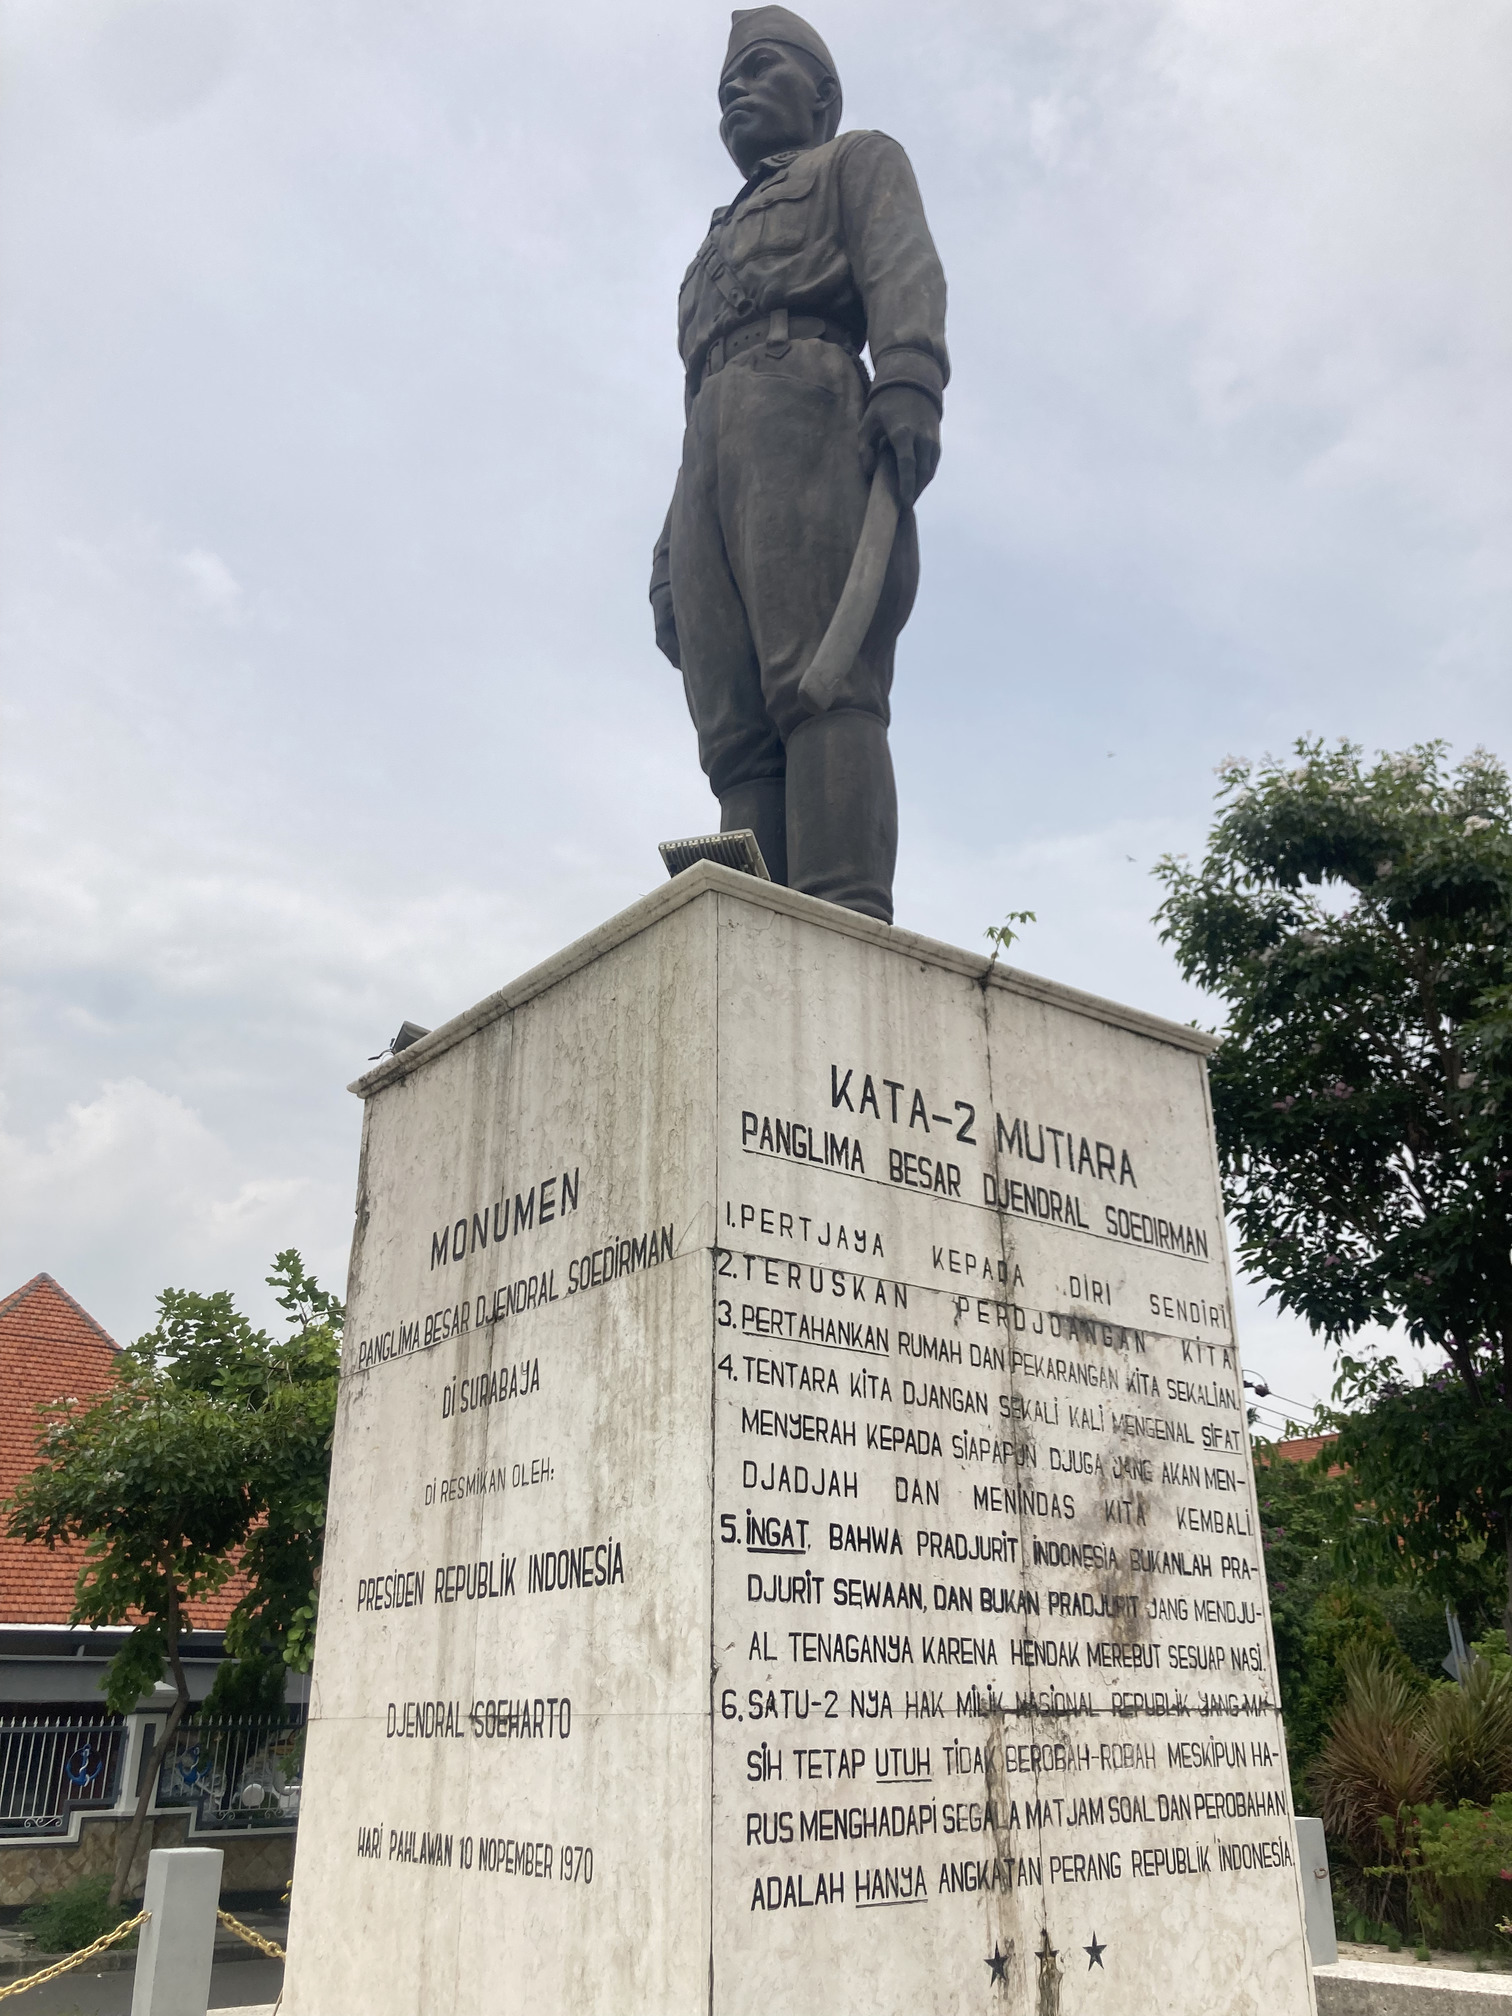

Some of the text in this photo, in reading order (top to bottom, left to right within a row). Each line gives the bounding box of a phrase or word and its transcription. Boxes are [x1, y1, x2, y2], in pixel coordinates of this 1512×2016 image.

[831, 1064, 1138, 1188] KATA-2 MUTIARA
[430, 1167, 579, 1270] MONUMEN
[742, 1111, 1209, 1259] PANGLIMA BESAR DJENDRAL SOEDIRMAN
[358, 1223, 674, 1370] PANGLIMA BESAR DJENDRAL SOEDIRMAN
[933, 1245, 1024, 1287] KEPADA
[1069, 1274, 1111, 1306] DIRI
[1150, 1294, 1228, 1330] SENDIRI
[899, 1331, 962, 1364] RUMAH
[970, 1343, 1005, 1371] DAN
[1012, 1351, 1119, 1391] PEKARANGAN
[1128, 1367, 1160, 1398] KITA
[1182, 1336, 1232, 1370] KITA
[850, 1368, 892, 1402] KITA
[903, 1380, 988, 1415] DJANGAN
[999, 1395, 1059, 1425] SEKALI
[1069, 1404, 1104, 1432] KALI
[1112, 1411, 1195, 1444] MENGENAL
[1203, 1423, 1240, 1450] SIFAT
[440, 1467, 506, 1503] RESMIKAN
[512, 1457, 555, 1488] OLEH:
[742, 1406, 856, 1447] MENYERAH
[866, 1421, 943, 1458] KEPADA
[952, 1429, 1037, 1468] SIAPAPUN
[1050, 1447, 1104, 1477] DJUGA
[1162, 1461, 1200, 1488] AKAN
[1204, 1467, 1246, 1492] MEN-
[742, 1460, 858, 1499] DJADJAH
[895, 1476, 940, 1506] DAN
[973, 1482, 1075, 1519] MENINDAS
[1105, 1498, 1146, 1527] KITA
[357, 1536, 624, 1612] PRESIDEN REPUBLIK INDONESIA
[829, 1523, 903, 1556] BAHWA
[917, 1529, 1019, 1564] PRADJURIT
[1033, 1534, 1119, 1570] INDONESIA
[1130, 1548, 1212, 1578] BUKANLAH
[1221, 1556, 1259, 1580] PRA-
[748, 1569, 824, 1604] DJURIT
[834, 1578, 927, 1613] SEWAAN,
[934, 1584, 973, 1612] DAN
[980, 1587, 1039, 1615] BUKAN
[1048, 1591, 1139, 1619] PRADJURIT
[1194, 1600, 1262, 1624] MENDJU-
[749, 1631, 1266, 1672] AL TENAGANYA KARENA HENDAK MEREBUT SESUAP NASI.
[387, 1697, 572, 1739] DJENDRAL SOEHARTO
[905, 1691, 944, 1718] HAK
[1112, 1689, 1190, 1717] REPUBLIK
[746, 1741, 782, 1782] SIH
[797, 1748, 866, 1780] TETAP
[875, 1747, 931, 1776] UTUH
[943, 1738, 997, 1775] TIDAK
[1167, 1735, 1247, 1769] MESKIPUN
[1251, 1742, 1279, 1768] HA-
[357, 1822, 593, 1885] HARI PAHLAWAN 10 NOPEMBER 1970
[746, 1812, 794, 1846] RUS
[800, 1796, 937, 1842] MENGHADAPI
[1025, 1797, 1104, 1830] MATJAM
[1108, 1795, 1155, 1823] SOAL
[1158, 1794, 1191, 1822] DAN
[750, 1870, 845, 1912] ADALAH
[855, 1866, 927, 1905] HANYA
[939, 1857, 1042, 1894] ANGKATAN
[1050, 1851, 1121, 1884] PERANG
[1131, 1840, 1211, 1877] REPUBLIK
